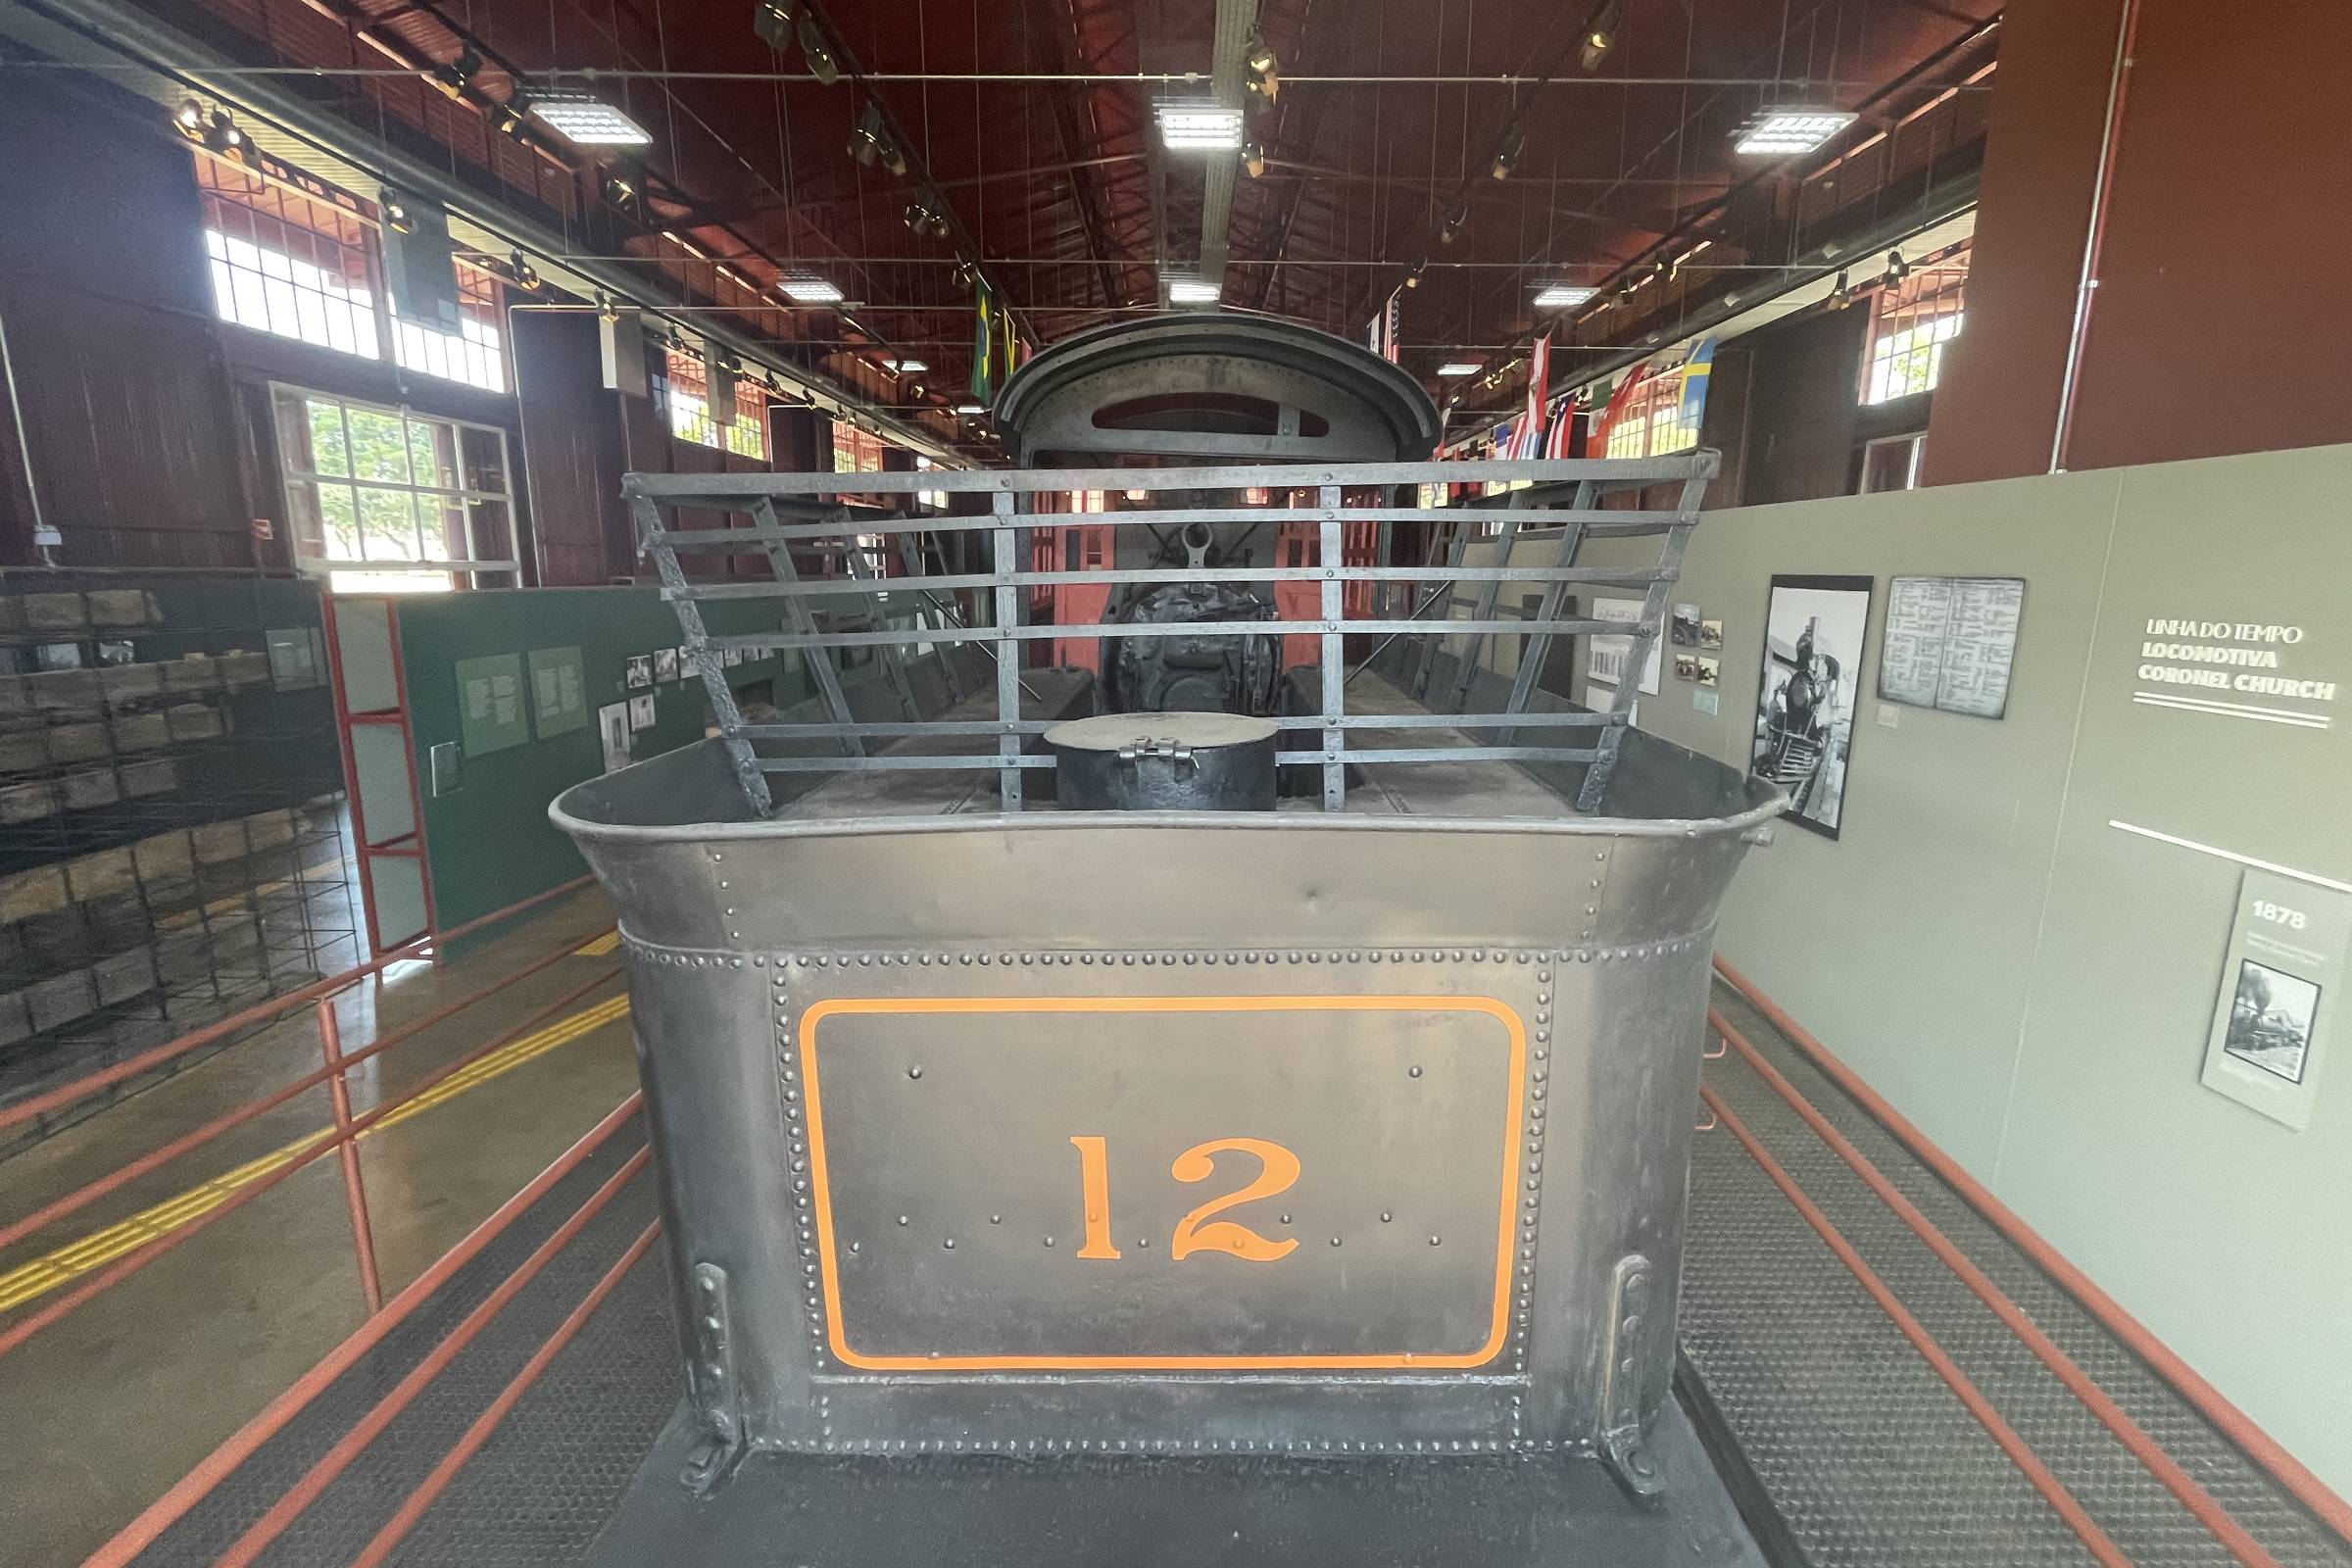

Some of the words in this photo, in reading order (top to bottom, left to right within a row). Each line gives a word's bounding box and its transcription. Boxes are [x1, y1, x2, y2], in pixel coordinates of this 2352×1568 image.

[2146, 618, 2197, 638] LINHA
[2199, 621, 2231, 639] DO
[2233, 623, 2303, 644] TEMPO
[2141, 642, 2278, 668] LOCOMOTIVA
[2137, 663, 2230, 690] CORONEL
[2233, 674, 2336, 701] CHURCH
[2252, 900, 2307, 930] 1878
[1070, 1136, 1301, 1262] 12
